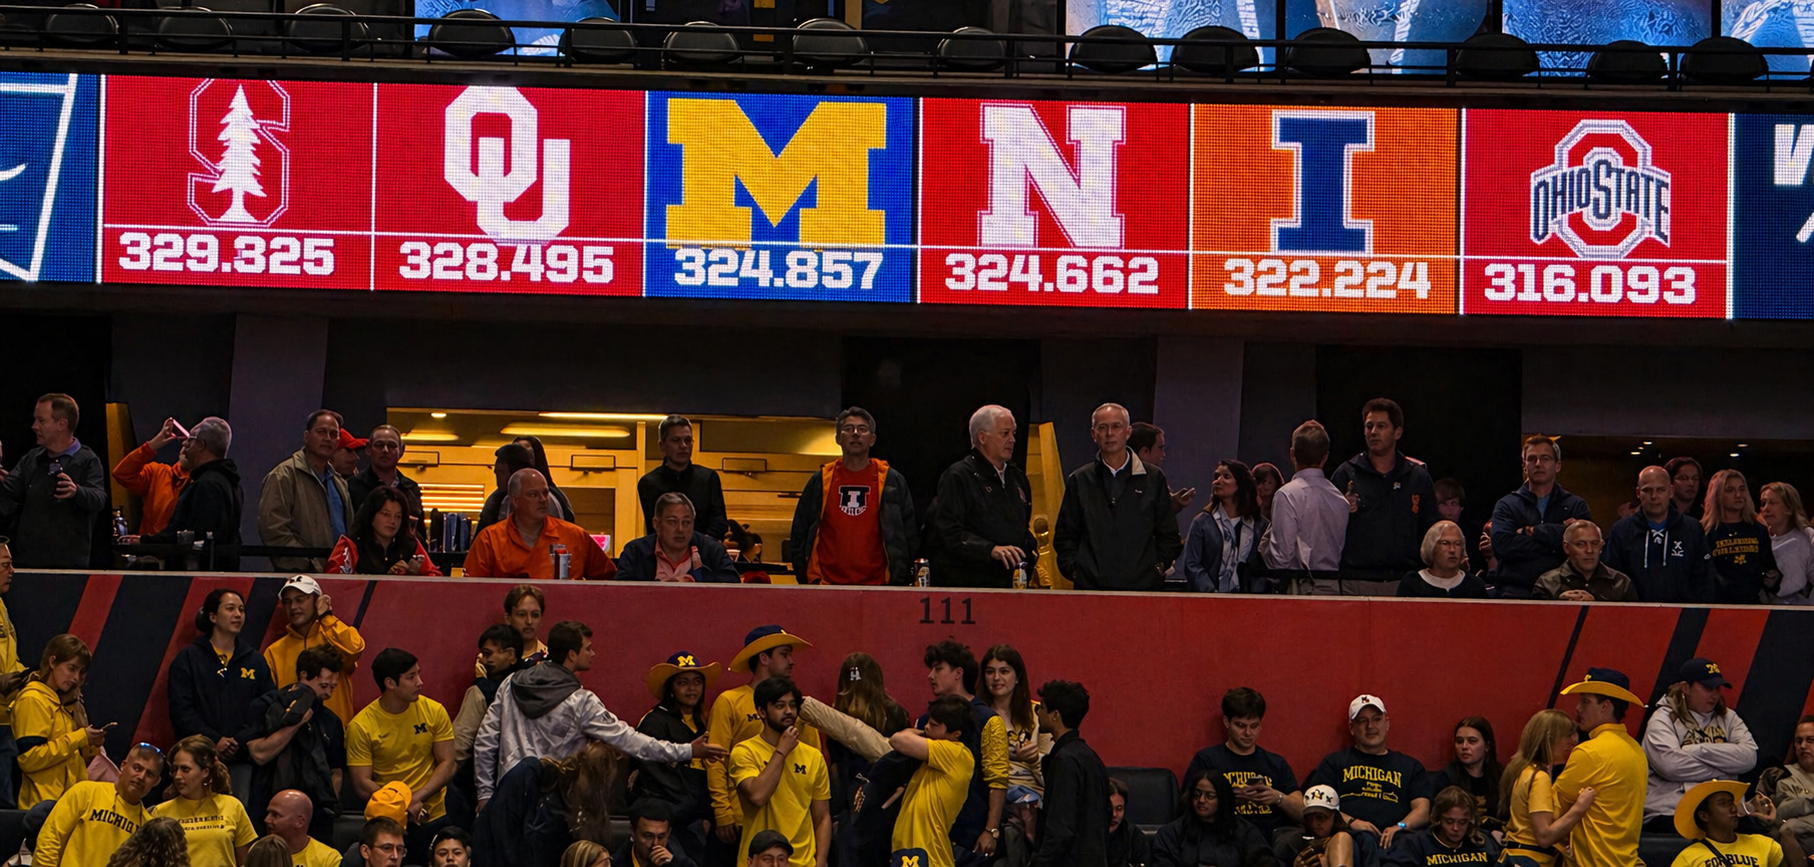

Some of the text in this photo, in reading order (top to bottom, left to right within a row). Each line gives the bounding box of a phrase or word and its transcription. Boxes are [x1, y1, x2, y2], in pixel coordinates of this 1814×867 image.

[666, 97, 887, 249] M
[978, 102, 1126, 248] N
[1271, 110, 1375, 254] I
[119, 231, 335, 276] 329.325
[399, 242, 614, 284] 328.495
[674, 247, 884, 290] 324.857
[944, 255, 1159, 295] 324.662
[1223, 258, 1431, 300] 322.224
[1484, 264, 1696, 305] 316.093
[919, 597, 976, 625] 111
[240, 667, 256, 680] M
[677, 654, 696, 668] M
[413, 722, 428, 735] M
[793, 763, 807, 775] M
[1342, 765, 1402, 789] MICHIGAN
[89, 808, 141, 834] MICHIG
[1426, 852, 1488, 866] MICHIGAN
[1725, 853, 1760, 867] BLUE
